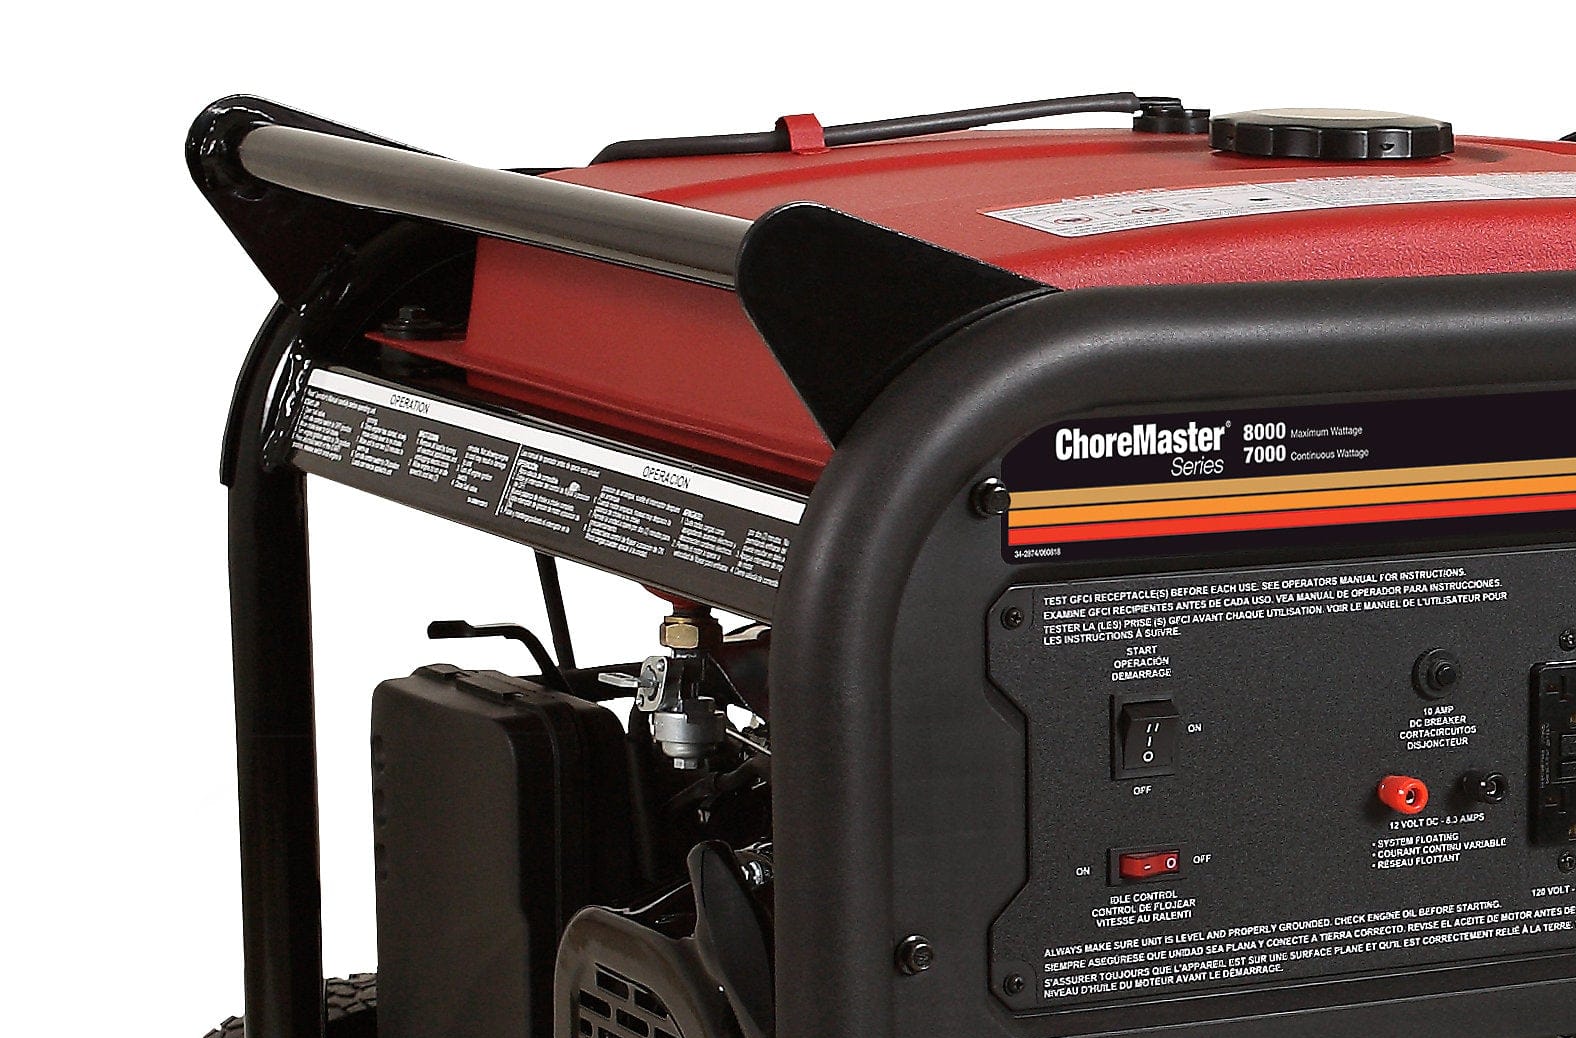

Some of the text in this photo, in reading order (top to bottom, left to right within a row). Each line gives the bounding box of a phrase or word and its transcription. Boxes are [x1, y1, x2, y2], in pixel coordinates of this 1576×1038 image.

[389, 394, 430, 414] OPERATION
[1243, 422, 1363, 441] 8000 Maximum Wattage
[1243, 444, 1370, 464] 7000 Continuous Wattage
[1170, 457, 1224, 477] Series
[1044, 596, 1067, 605] TEST
[1070, 595, 1092, 604] GFCI
[1095, 590, 1168, 602] RECEPTACLE(S)
[1171, 586, 1208, 597] BEFORE
[1211, 585, 1236, 594] EACH
[1262, 581, 1280, 590] SEE
[1282, 577, 1337, 588] OPERATORS
[1340, 575, 1377, 584] MANUAL
[1380, 573, 1398, 581] FOR
[1088, 608, 1110, 616] GFCI
[1113, 603, 1173, 614] RECIPIENTES
[1176, 600, 1206, 610] ANTES
[1224, 598, 1249, 607] CADA
[1276, 594, 1294, 603] VEA
[1297, 591, 1334, 601] MANUAL
[1351, 586, 1401, 597] OPERADOR
[1404, 585, 1428, 593] PARA
[1044, 624, 1080, 634] TESTER
[1083, 623, 1095, 631] LA
[1098, 621, 1121, 631] (LES)
[1124, 618, 1151, 628] PRISE
[1169, 615, 1190, 624] GFCI
[1192, 613, 1223, 623] AVANT
[1226, 610, 1264, 620] CHAQUE
[1327, 604, 1348, 612] VOIR
[1350, 602, 1362, 611] LE
[1364, 600, 1401, 610] MANUEL
[1483, 592, 1507, 601] POUR
[1044, 631, 1133, 645] LES INSTRUCTIONS
[1127, 646, 1157, 656] START
[1435, 706, 1454, 714] AMP
[1188, 724, 1201, 732] ON
[1410, 716, 1466, 728] DC BREAKER
[1400, 726, 1476, 739] CORTACIRCUITOS
[1401, 813, 1484, 828] VOLT DC AMPS
[1378, 833, 1458, 848] SYSTEM FLOATING
[1378, 838, 1506, 858] COURANT CONTINU VARIABLE
[1416, 853, 1460, 865] FLOTTANT
[1076, 867, 1090, 876] ON
[1111, 891, 1178, 904] IDLE CONTROL
[1532, 888, 1545, 896] 120
[1548, 885, 1570, 895] VOLT
[1092, 906, 1136, 917] CONTROL
[1097, 910, 1191, 927] VITESSE AU RALENTI
[1045, 946, 1082, 957] ALWAYS
[1085, 942, 1112, 952] MAKE
[1114, 939, 1139, 949] SURE
[1142, 937, 1162, 946] UNIT
[1176, 932, 1204, 943] LEVEL
[1207, 930, 1226, 940] AND
[1229, 924, 1277, 936] PROPERLY
[1335, 915, 1365, 925] CHECK
[1368, 911, 1400, 922] ENGINE
[1403, 910, 1417, 918] OIL
[1419, 906, 1454, 916] BEFORE
[1045, 960, 1086, 972] SIEMPRE
[1147, 951, 1166, 960] QUE
[1169, 947, 1203, 958] UNIDAD
[1206, 945, 1224, 954] SEA
[1226, 941, 1256, 952] PLANA
[1266, 935, 1309, 947] CONECTE
[1320, 931, 1352, 941] TIERRA
[1408, 921, 1439, 932] REVISE
[1441, 920, 1452, 928] EL
[1454, 916, 1485, 926] ACEITE
[1501, 911, 1532, 921] MOTOR
[1534, 908, 1562, 918] ANTES
[1045, 930, 1493, 987] S'ASSURER TOUJOURS QUE SUR SURFACE PLANE CORRECTEMENT
[1044, 973, 1207, 998] NIVEAU MOTEUR AVANT
